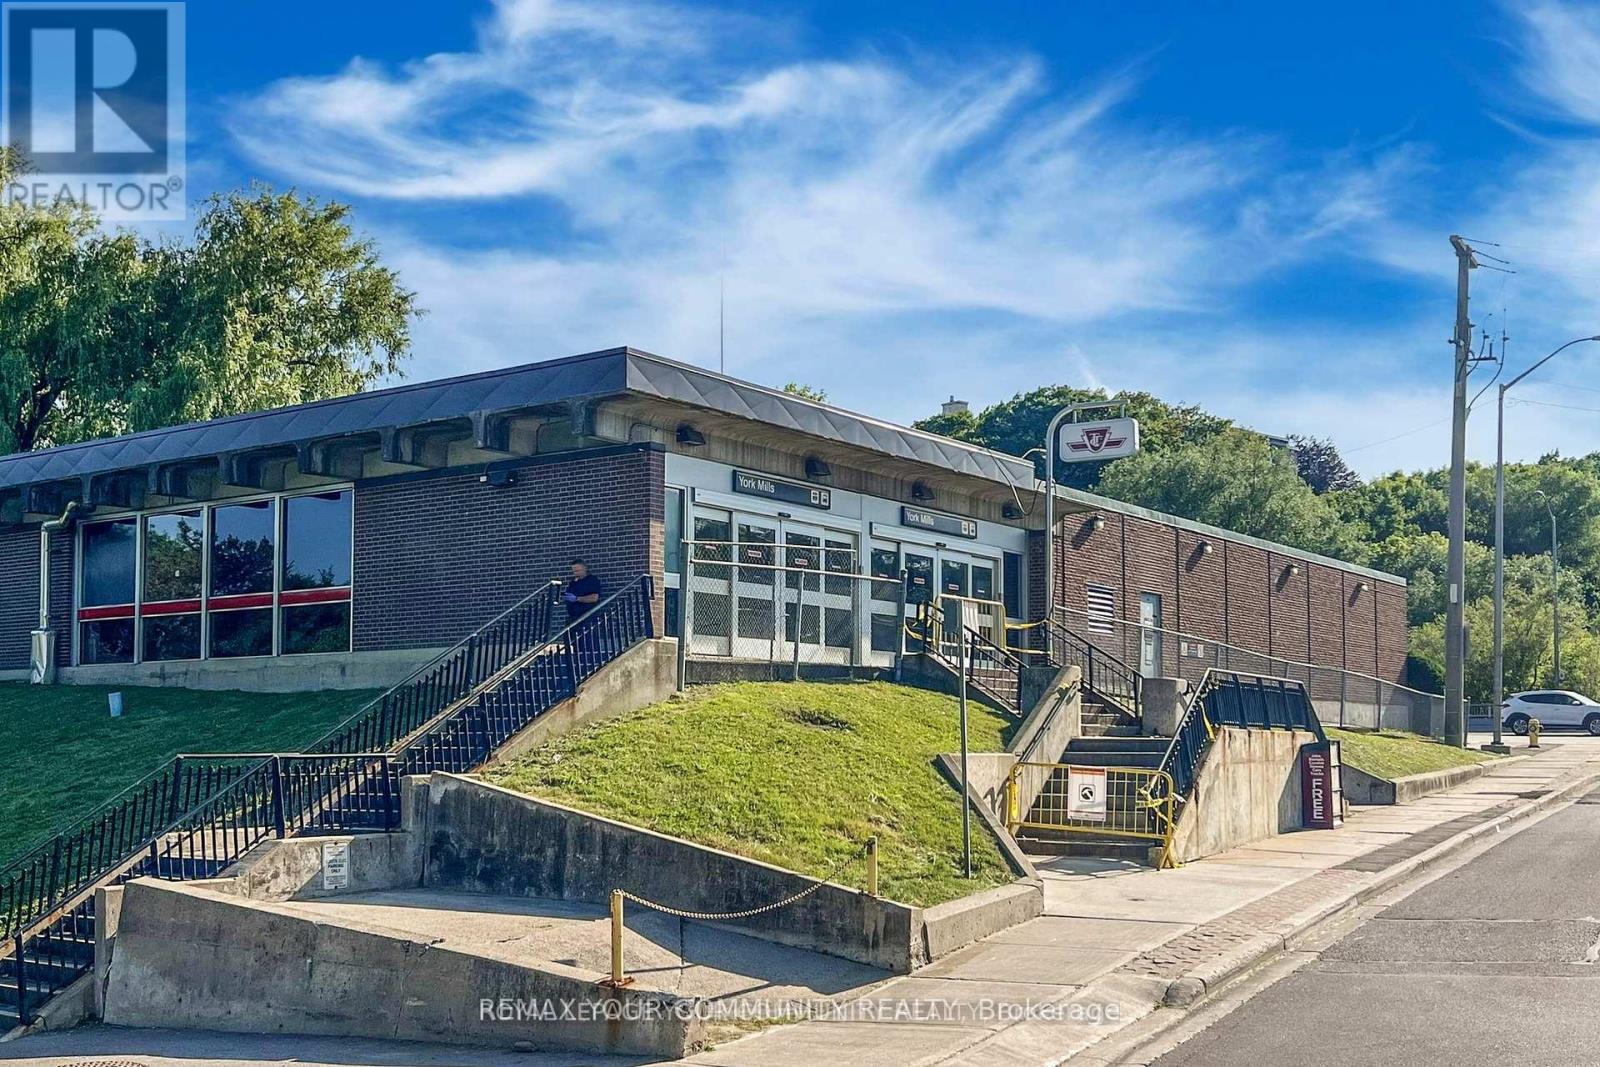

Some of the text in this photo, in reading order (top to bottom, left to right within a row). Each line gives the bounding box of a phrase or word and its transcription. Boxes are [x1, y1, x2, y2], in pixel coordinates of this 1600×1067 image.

[738, 475, 775, 494] York Mills
[906, 511, 934, 526] York Mills
[1312, 778, 1324, 819] FREE
